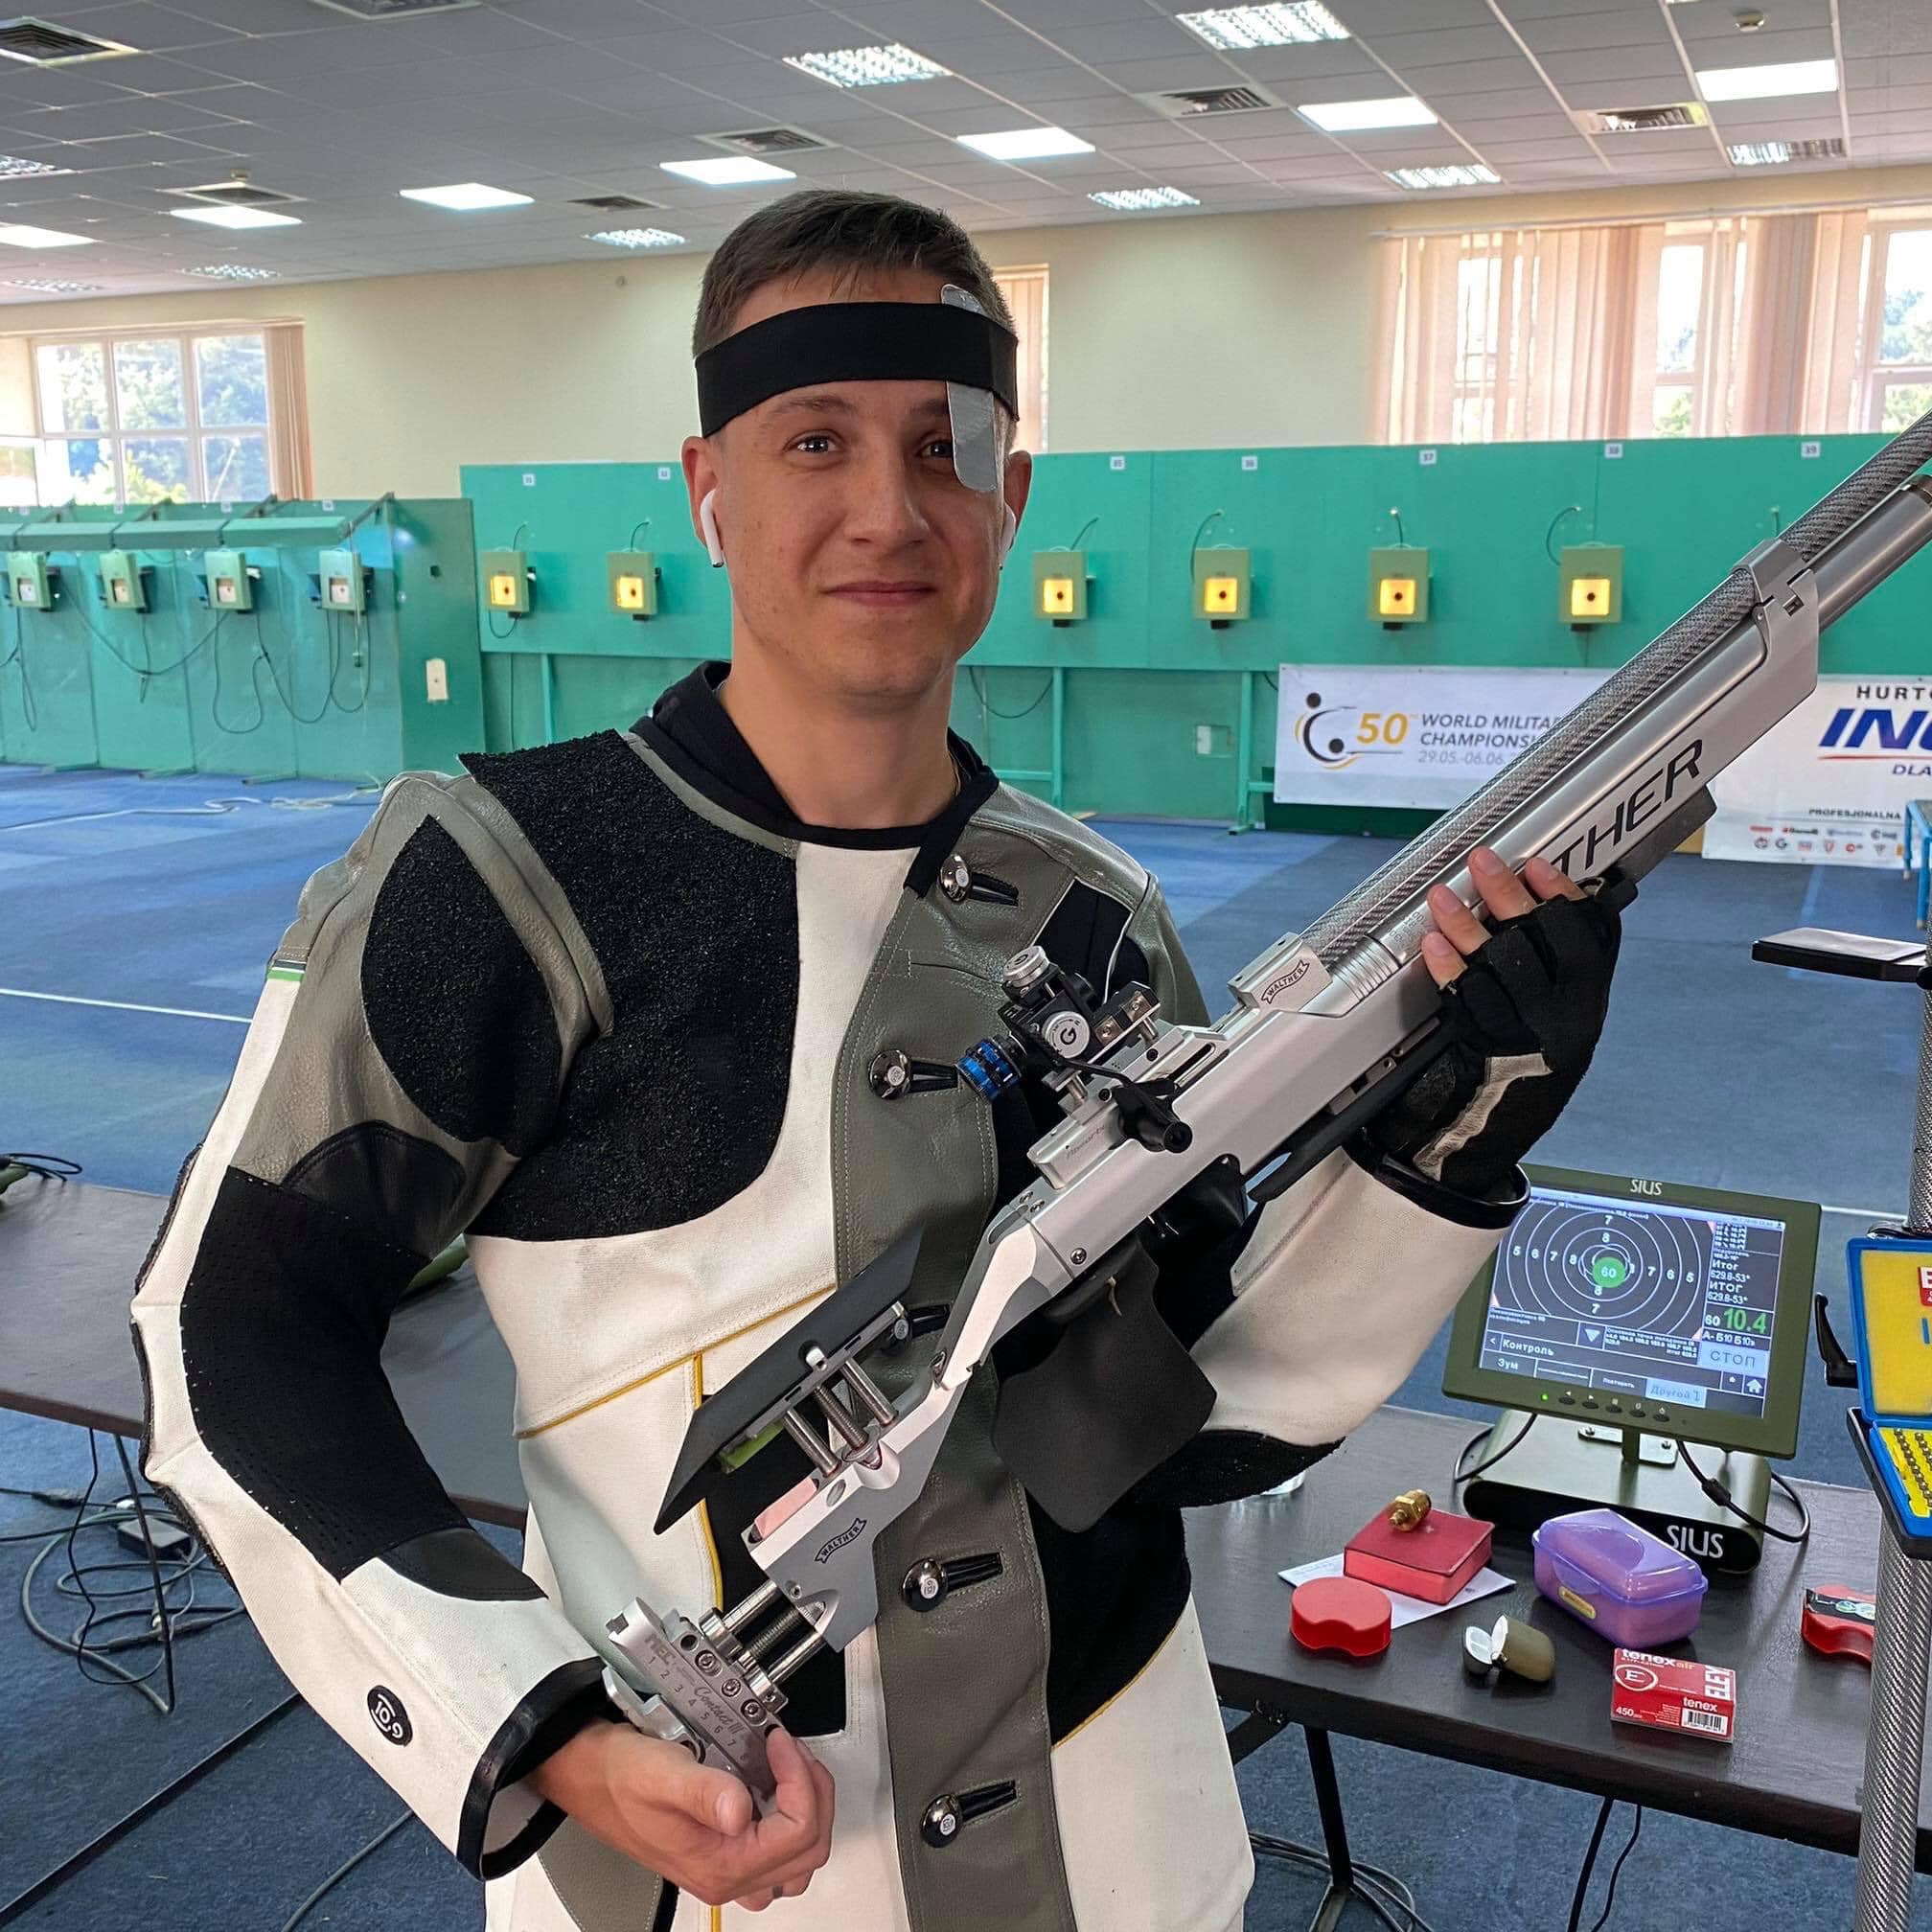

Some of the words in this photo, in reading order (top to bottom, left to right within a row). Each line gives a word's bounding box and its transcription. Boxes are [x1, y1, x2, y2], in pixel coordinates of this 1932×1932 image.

[1857, 685, 1932, 701] HURT
[1421, 714, 1487, 728] WORLD
[1356, 713, 1409, 746] 50
[1420, 731, 1535, 748] CHAMPIONS
[1892, 764, 1932, 776] DLA
[1550, 739, 1703, 878] THER
[1808, 808, 1902, 820] PROFESJONALNA
[1267, 968, 1304, 996] WALTHER
[1629, 1179, 1664, 1196] SIUS
[1604, 1215, 1613, 1225] 7
[1601, 1232, 1610, 1243] 8
[1512, 1246, 1521, 1256] 5
[1531, 1249, 1539, 1259] 6
[1550, 1252, 1558, 1261] 7
[1569, 1254, 1577, 1265] 8
[1600, 1267, 1617, 1278] 60
[1647, 1266, 1656, 1276] 7
[1667, 1269, 1675, 1279] 6
[1686, 1272, 1694, 1282] 5
[1712, 1259, 1739, 1271] Итог
[1709, 1280, 1743, 1294] ИТОГ
[1591, 1303, 1600, 1314] 7
[1705, 1314, 1721, 1326] 60
[1724, 1307, 1767, 1334] 10.4
[1502, 1339, 1554, 1356] Контроль
[1497, 1358, 1519, 1370] Зум
[1710, 1350, 1757, 1368] СТОП
[1650, 1386, 1690, 1400] Другой
[820, 1526, 860, 1556] WALTHER
[1667, 1525, 1724, 1558] SIUS
[1616, 1706, 1634, 1716] 450
[1683, 1696, 1718, 1713] tenex
